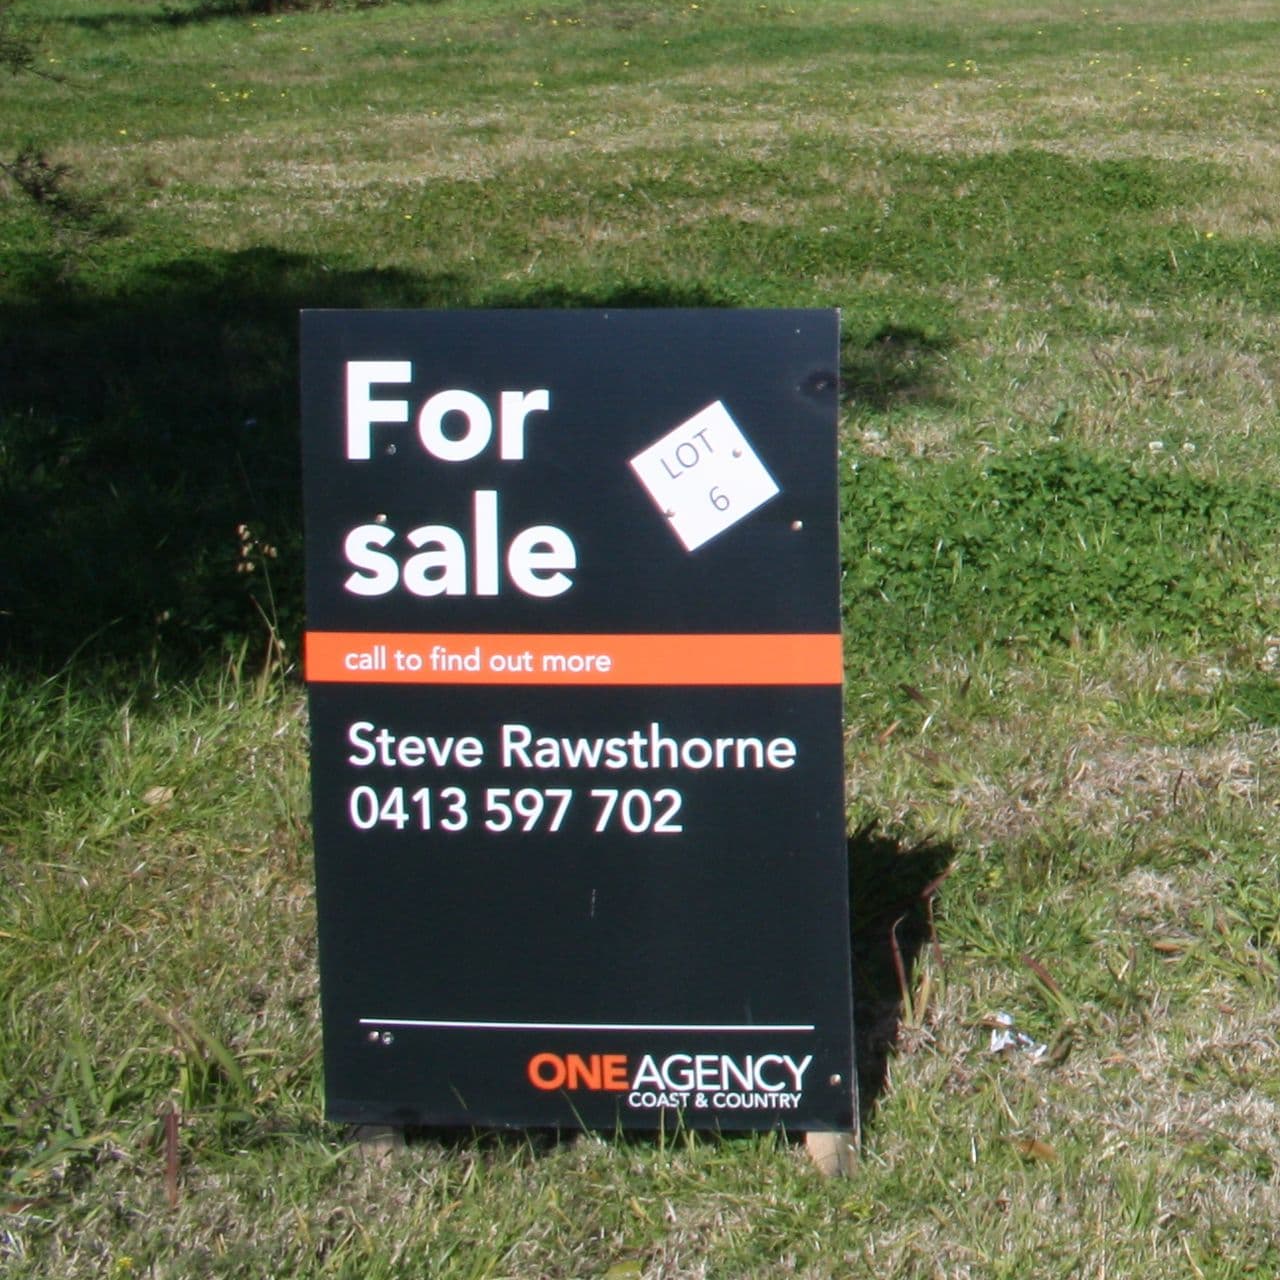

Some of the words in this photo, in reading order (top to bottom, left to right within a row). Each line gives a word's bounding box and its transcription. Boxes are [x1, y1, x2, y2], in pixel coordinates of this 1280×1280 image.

[345, 360, 550, 462] For
[660, 427, 715, 480] LOT
[709, 486, 730, 512] 6
[343, 489, 577, 598] sale
[344, 645, 387, 671] call
[395, 649, 423, 672] to
[429, 645, 481, 672] find
[488, 650, 534, 673] out
[541, 653, 612, 673] more
[348, 721, 484, 768] Steve
[501, 722, 797, 770] Rawsthorne
[349, 785, 468, 832] 0413
[484, 788, 572, 832] 597
[590, 788, 683, 833] 702
[628, 1092, 690, 1109] COAST
[694, 1092, 709, 1109] &
[711, 1092, 802, 1109] COUNTRY
